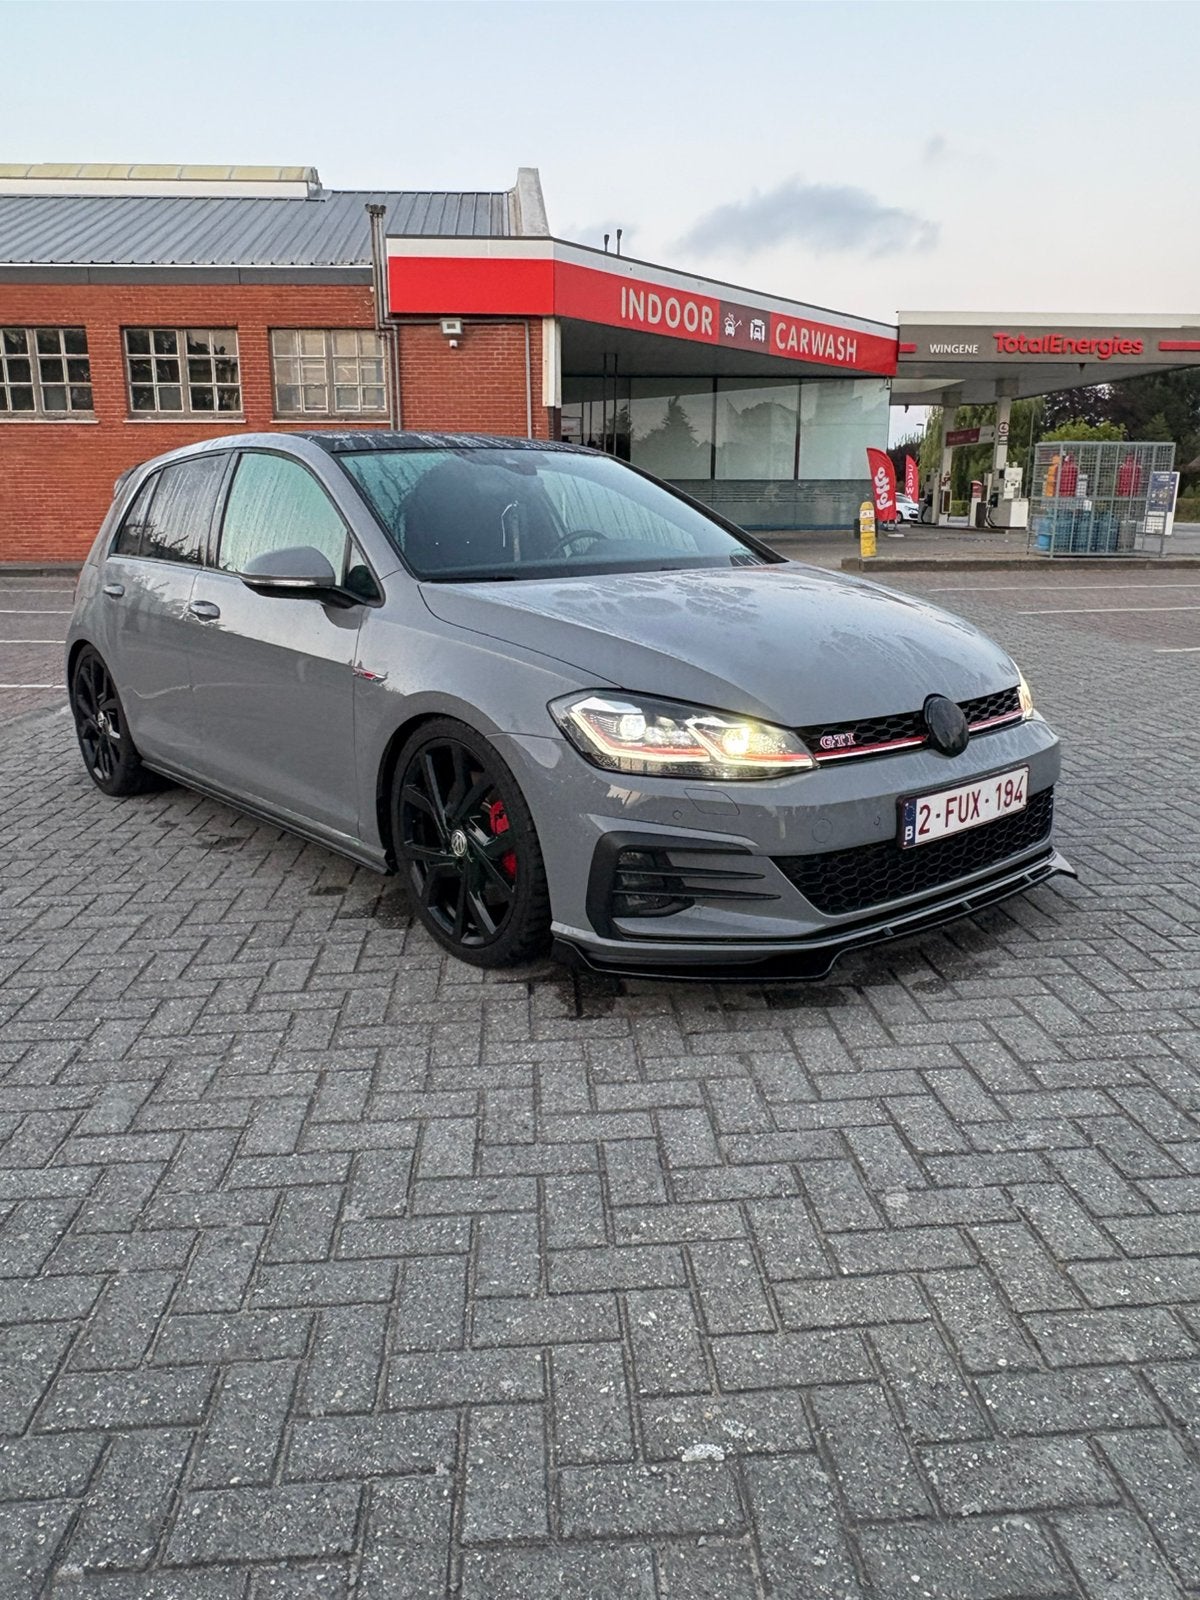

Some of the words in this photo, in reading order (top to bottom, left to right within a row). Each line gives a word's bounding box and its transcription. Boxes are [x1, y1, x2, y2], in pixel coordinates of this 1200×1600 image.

[621, 286, 712, 336] INDOOR
[775, 322, 857, 363] CARWASH
[929, 344, 979, 354] WINGENE
[993, 333, 1144, 360] TotalEnergies
[820, 732, 856, 749] GTI
[918, 775, 1024, 835] 2-FUX-194
[904, 825, 913, 840] B
